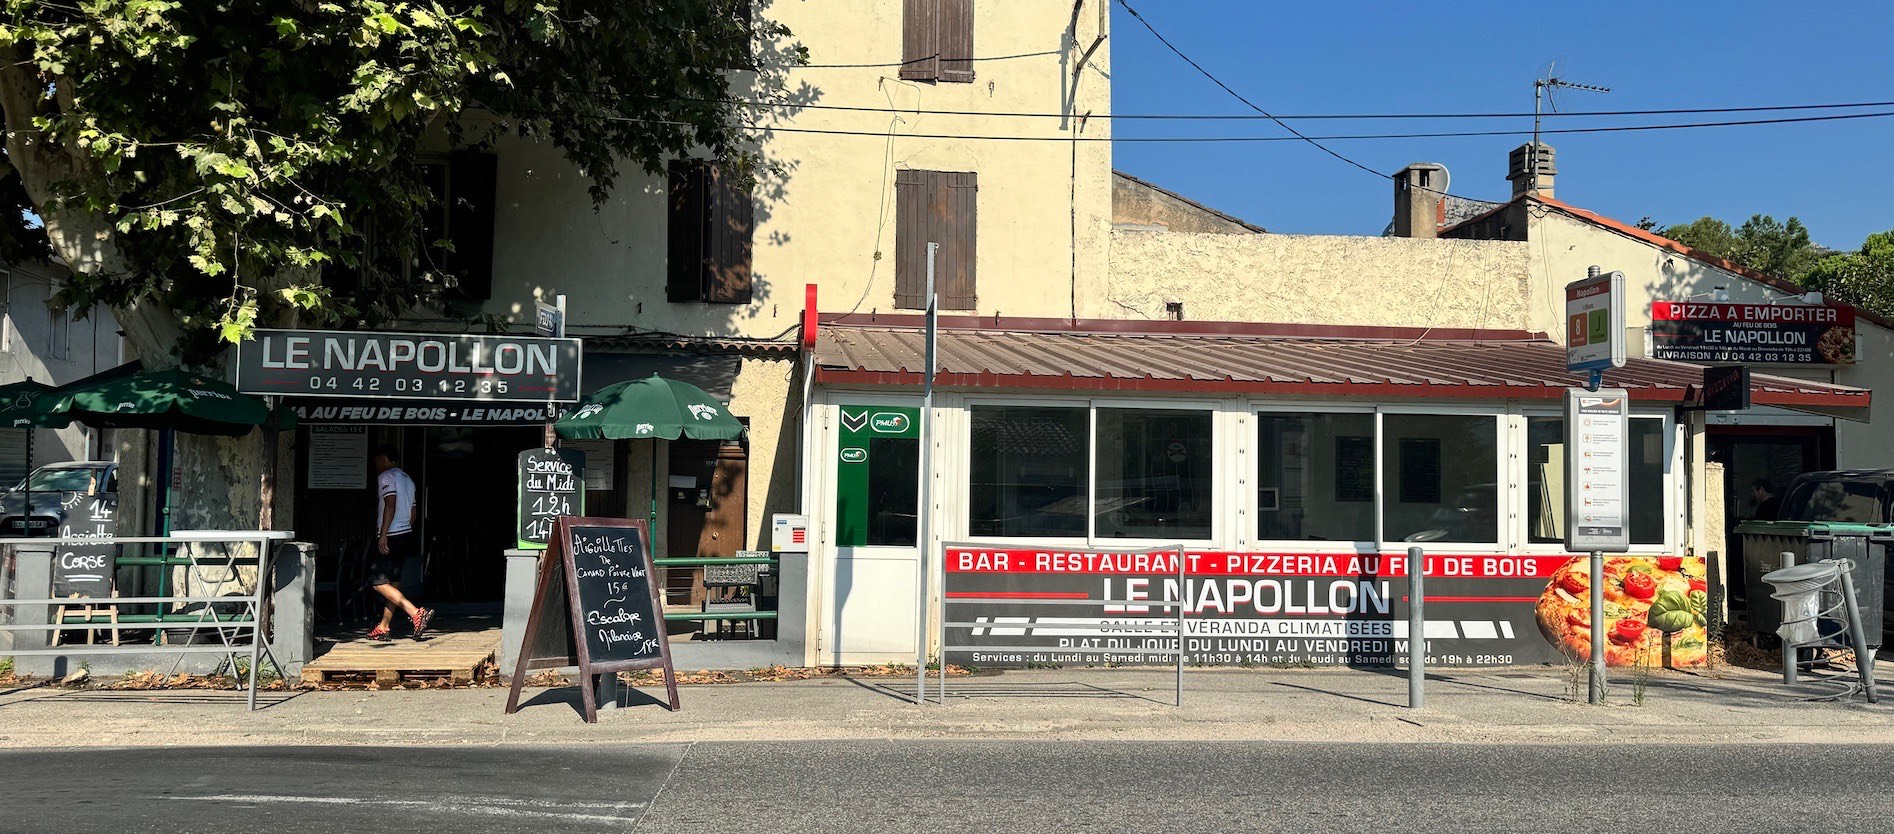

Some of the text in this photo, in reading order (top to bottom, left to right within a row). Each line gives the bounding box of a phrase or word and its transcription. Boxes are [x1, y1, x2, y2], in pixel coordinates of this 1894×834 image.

[1576, 286, 1600, 298] Napollon
[1670, 304, 1837, 322] PIZZA A EMPORTER
[1575, 315, 1601, 336] 8 J
[1704, 329, 1806, 345] LE NAPOLLON
[262, 336, 558, 375] LE NAPOLLON
[1657, 351, 1811, 362] LIVRAISON AU 04 42 03 12 35
[310, 376, 508, 394] 04 42 03 12 35
[310, 406, 338, 419] AU
[339, 407, 376, 419] FEU
[377, 407, 403, 420] DE
[404, 407, 447, 420] BOIS
[461, 408, 485, 421] LE
[486, 408, 568, 421] NAPOL
[527, 455, 573, 474] Service
[526, 474, 575, 491] du Midi
[532, 495, 571, 515] 12h
[61, 524, 115, 546] Assiette
[526, 519, 553, 540] 14
[958, 552, 1009, 571] BAR
[1036, 553, 1205, 573] RESTAURANT
[1227, 555, 1338, 574] PIZZERIA
[1347, 557, 1379, 574] AU
[1444, 558, 1474, 576] DE
[1483, 558, 1537, 577] BOIS
[1104, 578, 1390, 615] LE NAPOLLON
[587, 608, 641, 626] Escalope
[1100, 620, 1153, 633] SALLE
[1187, 618, 1271, 634] VÉRANDA
[1278, 620, 1391, 635] CLIMATISÉES
[1059, 638, 1101, 649] PLAT
[1108, 638, 1131, 649] DU
[1189, 639, 1211, 651] DU
[1218, 639, 1269, 652] LUNDI
[1275, 640, 1298, 652] AU
[1304, 640, 1388, 653] VENDREDI
[1395, 641, 1431, 653] MI
[972, 653, 1022, 662] Services
[1033, 653, 1047, 662] du
[1051, 653, 1082, 662] Lundi
[1103, 653, 1144, 663] Samedi
[1149, 653, 1172, 662] midi
[1194, 653, 1231, 663] 11h30
[1235, 653, 1242, 663] à
[1246, 653, 1268, 663] 14h
[1338, 656, 1351, 664] au
[1355, 655, 1395, 664] Samedi
[1425, 655, 1437, 664] de
[1441, 655, 1462, 664] 19h
[1466, 655, 1472, 664] à
[1476, 655, 1512, 664] 22h30
